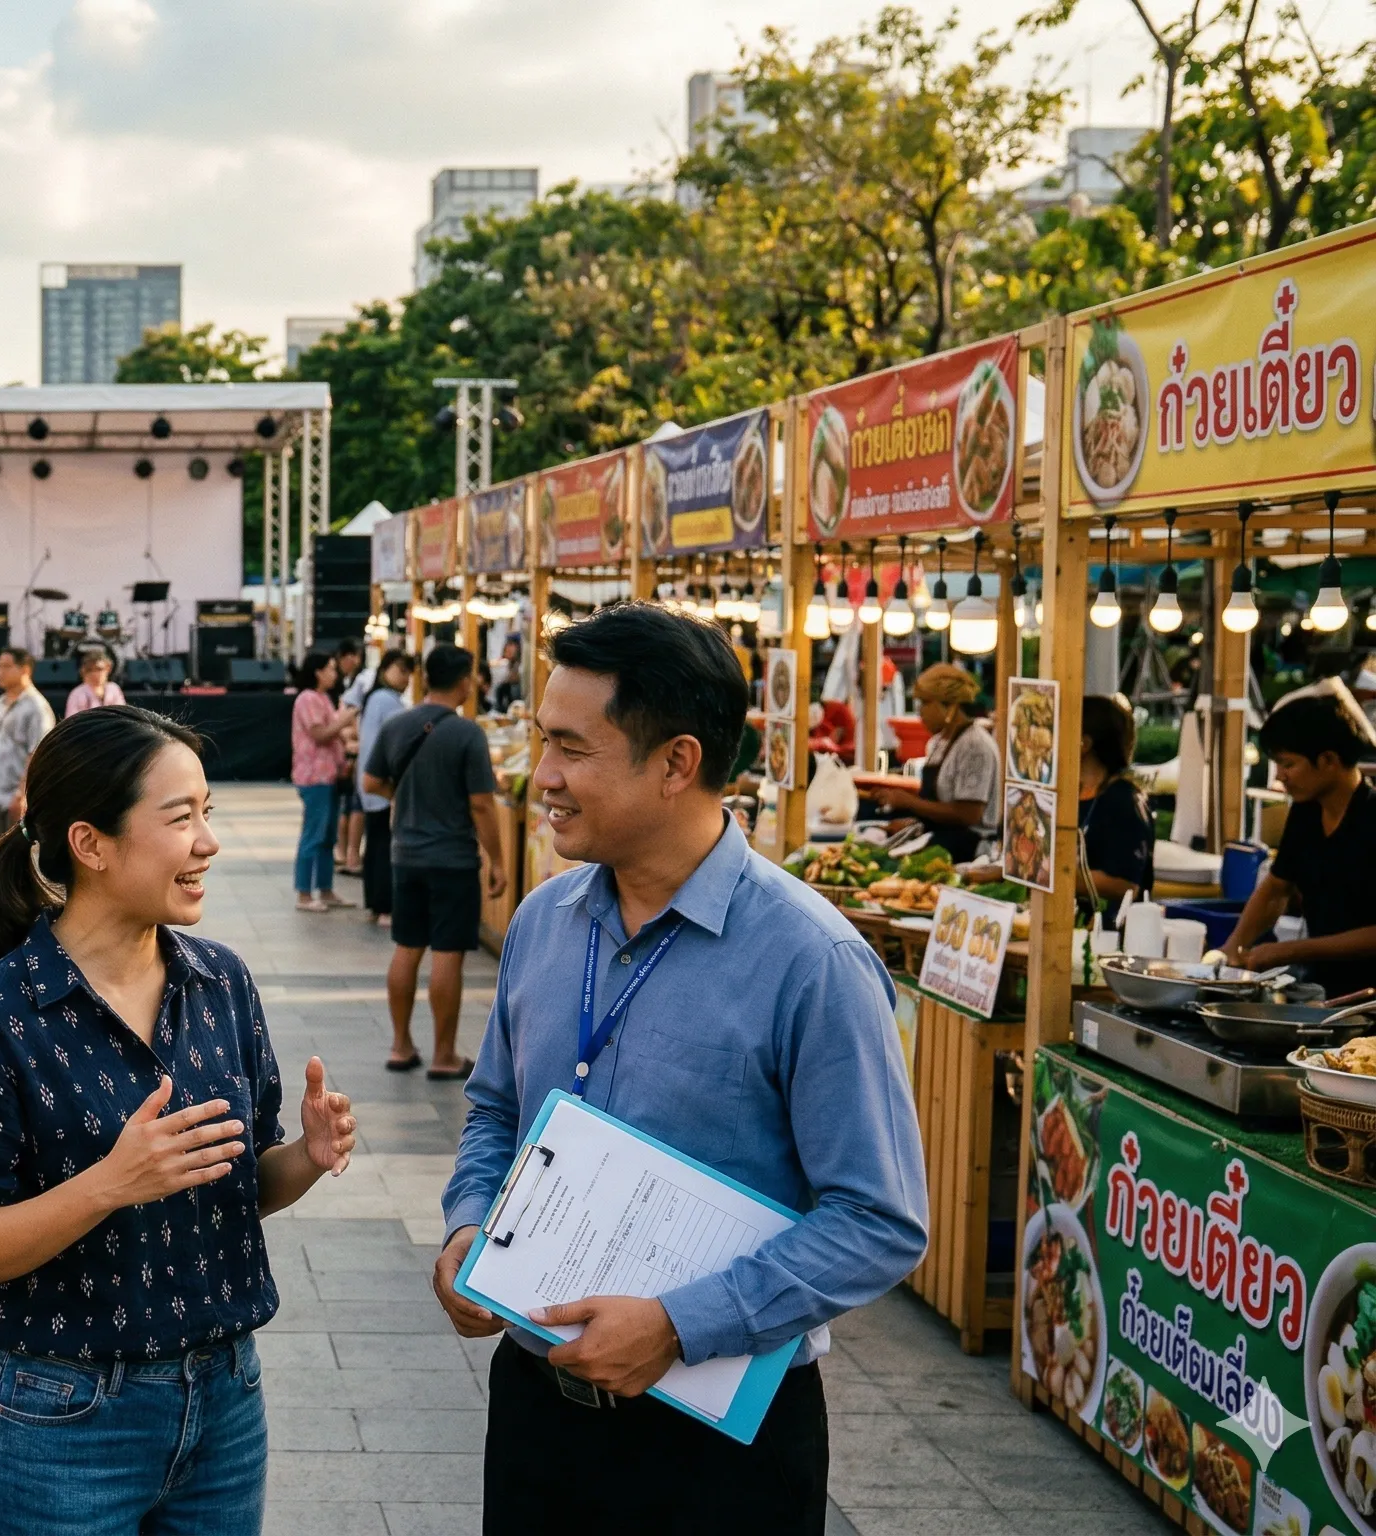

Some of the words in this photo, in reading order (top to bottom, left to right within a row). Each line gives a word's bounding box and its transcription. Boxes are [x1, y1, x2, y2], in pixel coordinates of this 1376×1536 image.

[1159, 281, 1359, 449] ก๋วยเตี๋ยว
[1107, 1134, 1305, 1347] ก๋วยเตี๋ยว
